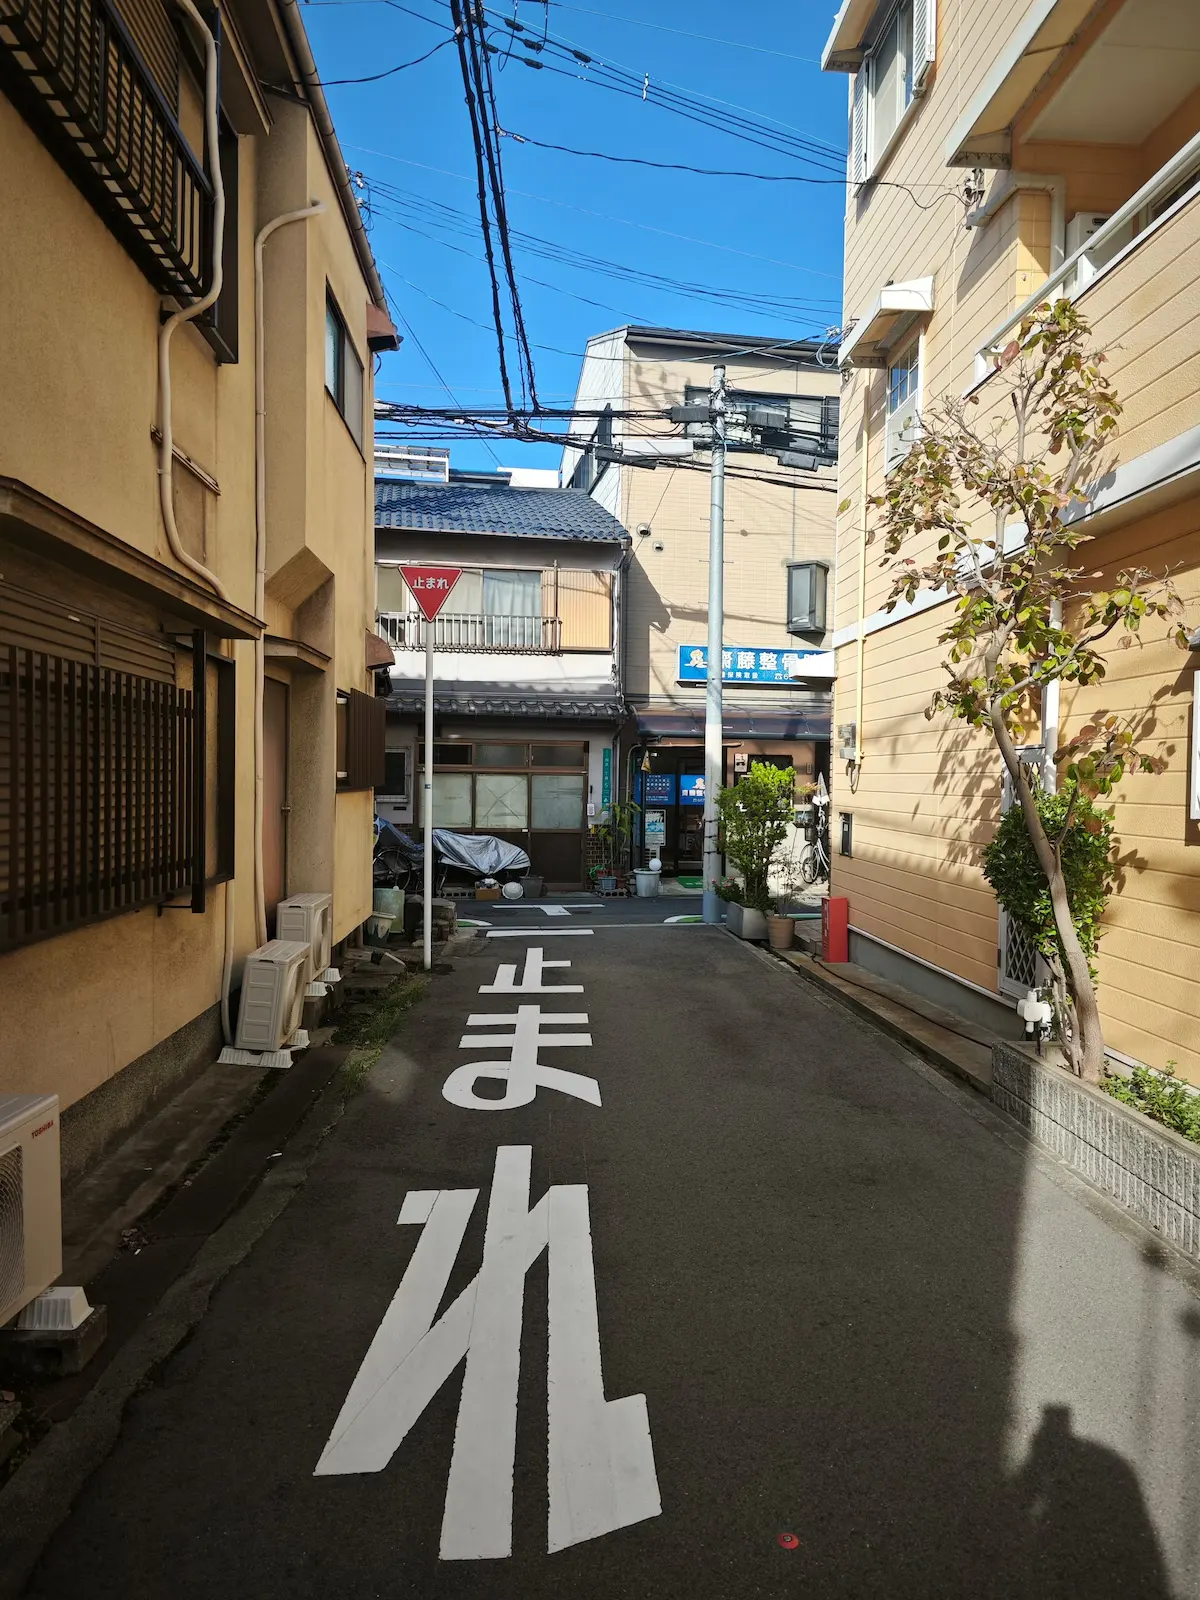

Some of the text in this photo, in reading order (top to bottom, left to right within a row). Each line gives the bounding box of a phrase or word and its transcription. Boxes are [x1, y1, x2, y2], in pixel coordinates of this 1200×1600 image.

[412, 576, 449, 590] 止まれ
[31, 1120, 54, 1139] TOSHIBA
[312, 947, 662, 1561] 止まれ
